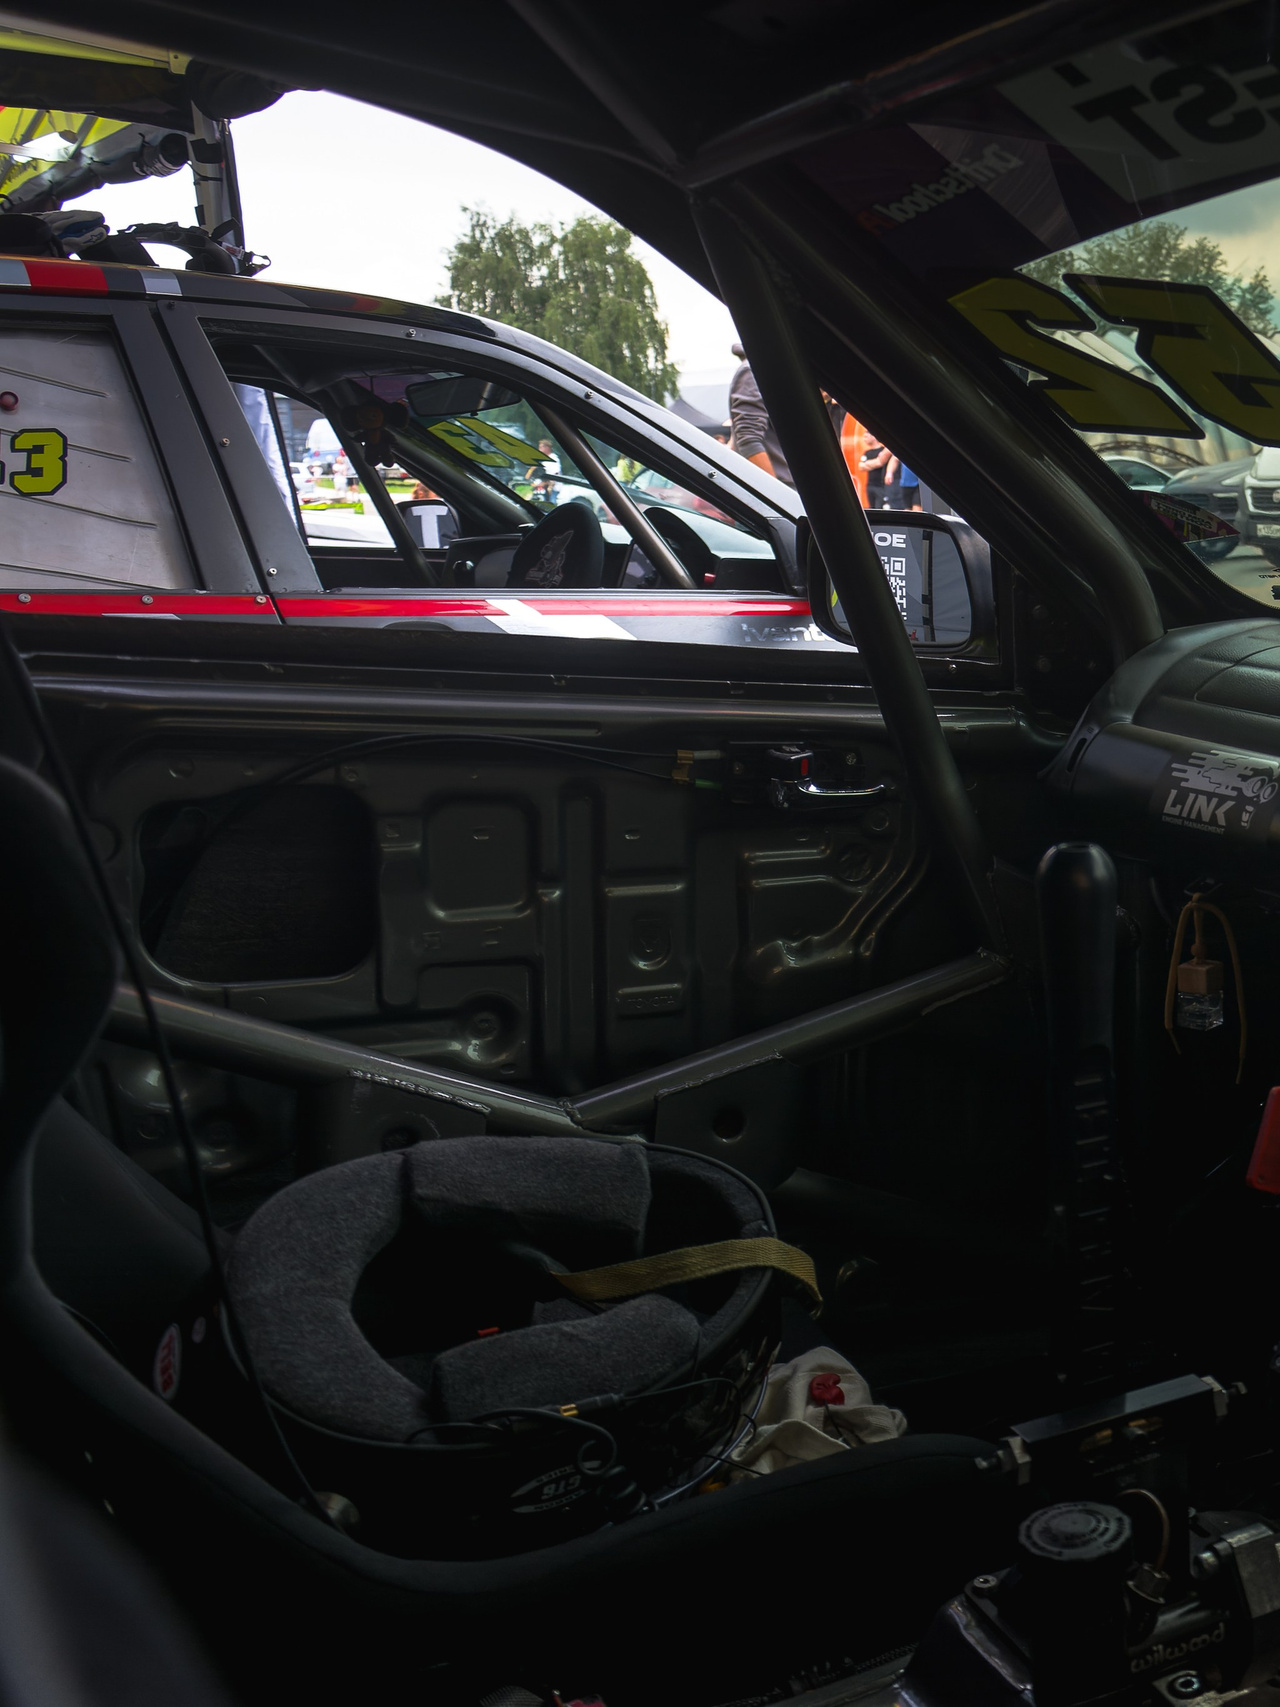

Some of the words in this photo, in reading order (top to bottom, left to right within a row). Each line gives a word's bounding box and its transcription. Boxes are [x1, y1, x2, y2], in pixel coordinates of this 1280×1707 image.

[0, 427, 68, 497] 3
[871, 532, 907, 548] OE
[740, 623, 826, 642] ivant
[1163, 788, 1237, 826] LINK
[1183, 818, 1226, 836] MANAGEMENT
[1130, 1621, 1227, 1675] wilwood
